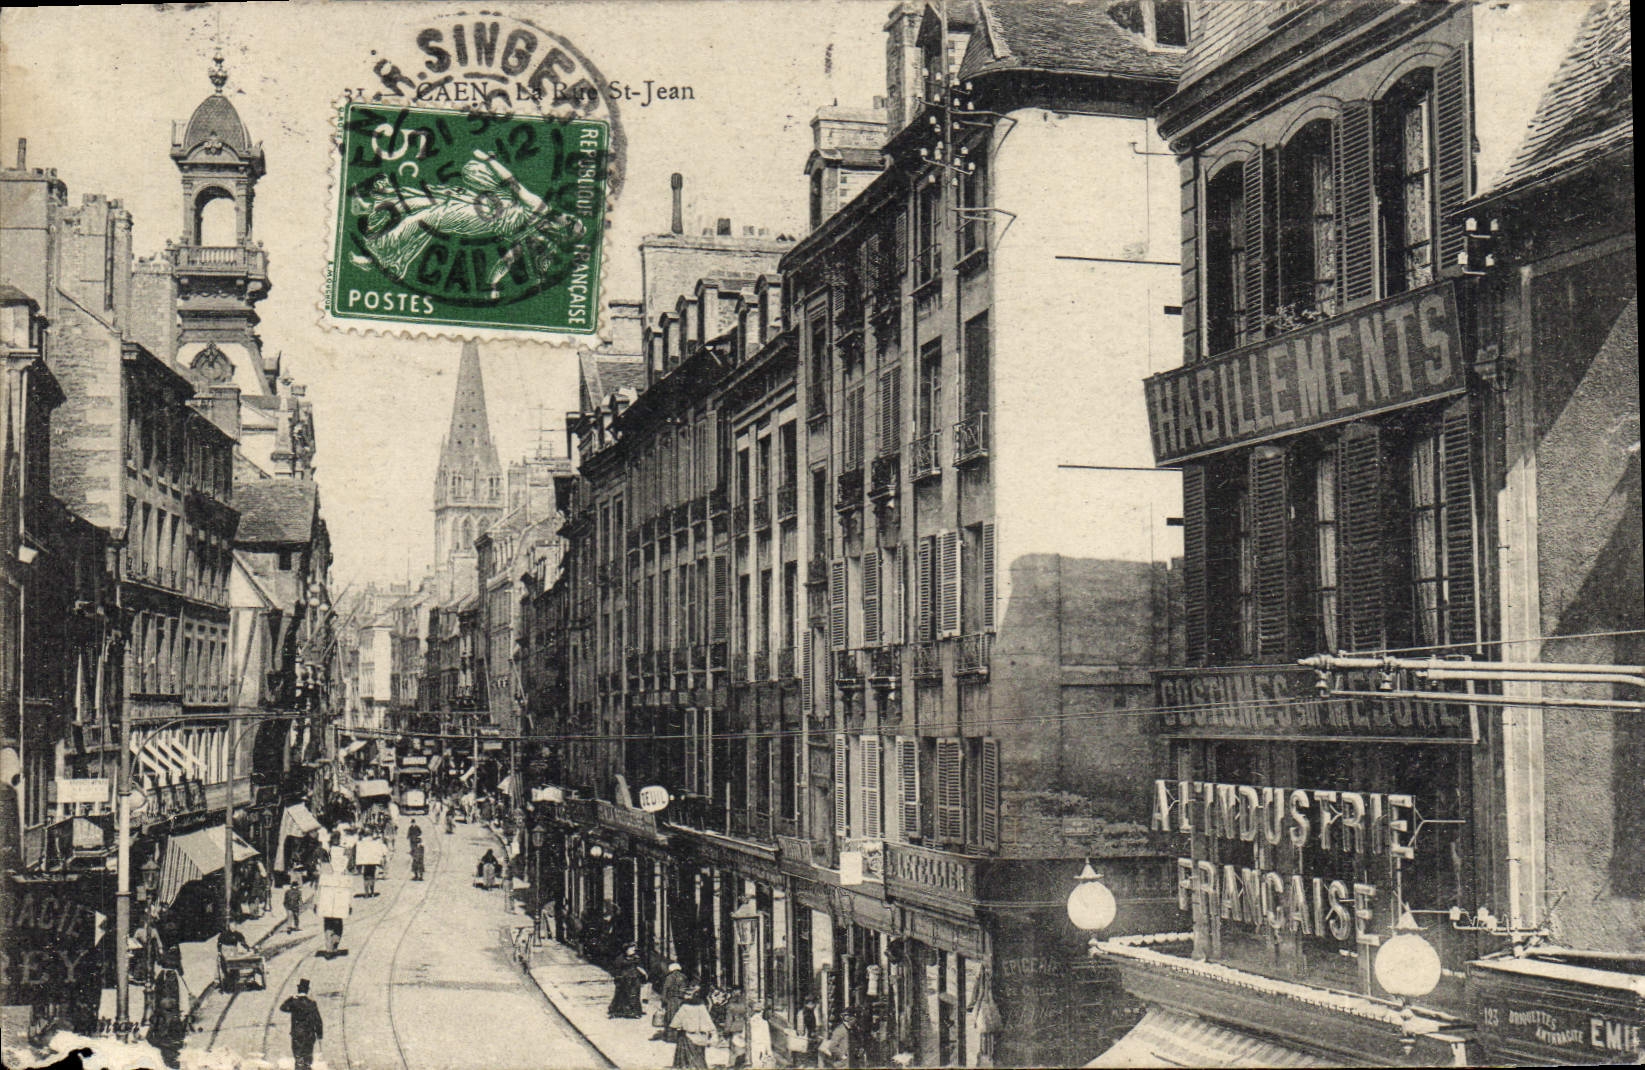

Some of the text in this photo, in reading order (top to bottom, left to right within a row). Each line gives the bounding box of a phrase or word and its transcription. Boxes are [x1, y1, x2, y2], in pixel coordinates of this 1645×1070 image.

[416, 20, 601, 126] SINGER
[371, 122, 428, 161] 5
[348, 289, 434, 315] POSTES
[1154, 294, 1451, 457] HABILLEMENTS
